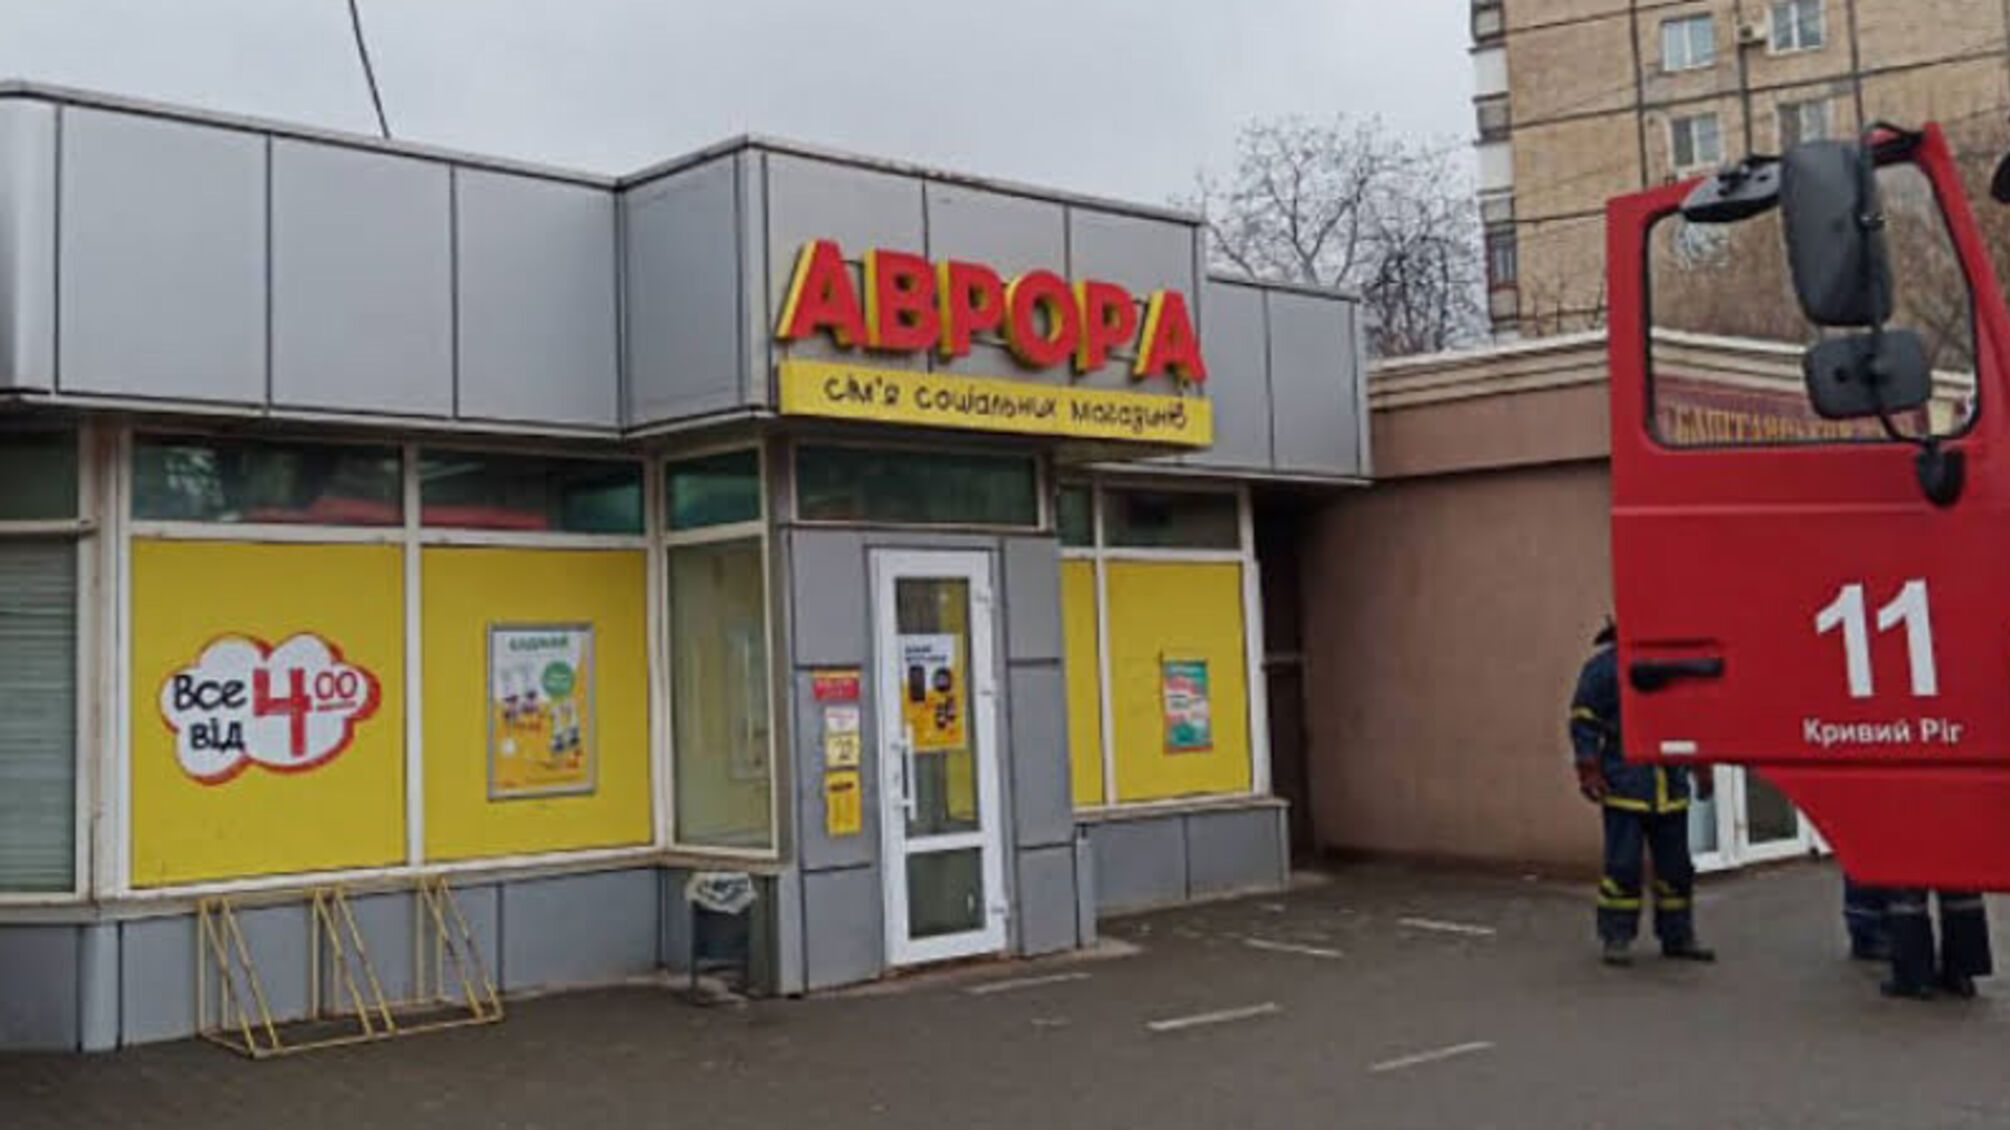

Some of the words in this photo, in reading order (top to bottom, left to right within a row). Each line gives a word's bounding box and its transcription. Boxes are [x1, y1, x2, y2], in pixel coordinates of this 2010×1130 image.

[777, 239, 1207, 382] АВРОРА
[1814, 577, 1938, 698] 11
[173, 673, 248, 712] Все
[190, 717, 247, 754] від
[1804, 717, 1912, 746] Кривий
[1920, 719, 1963, 744] Ріг
